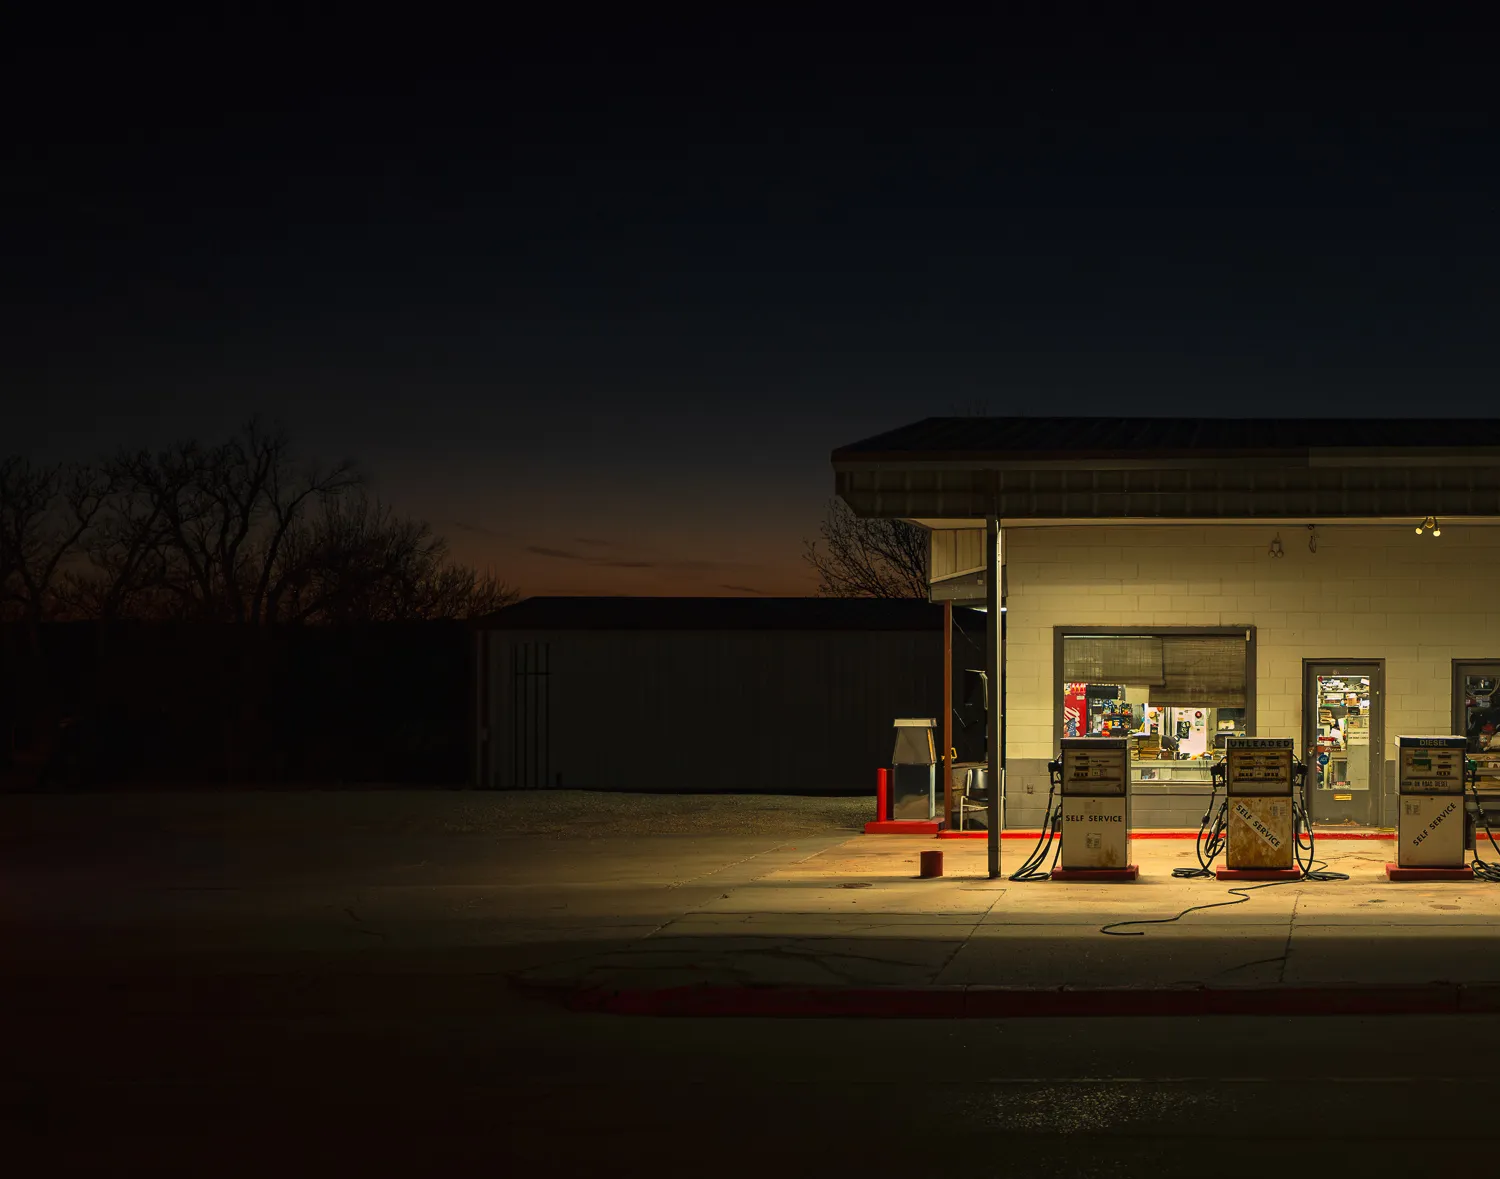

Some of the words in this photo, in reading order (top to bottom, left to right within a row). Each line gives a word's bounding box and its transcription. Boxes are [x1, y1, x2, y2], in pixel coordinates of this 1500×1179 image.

[1235, 804, 1253, 820] SELF
[1252, 820, 1280, 847] SERVICE
[1413, 829, 1428, 846] SELF
[1429, 802, 1456, 830] SERVICE
